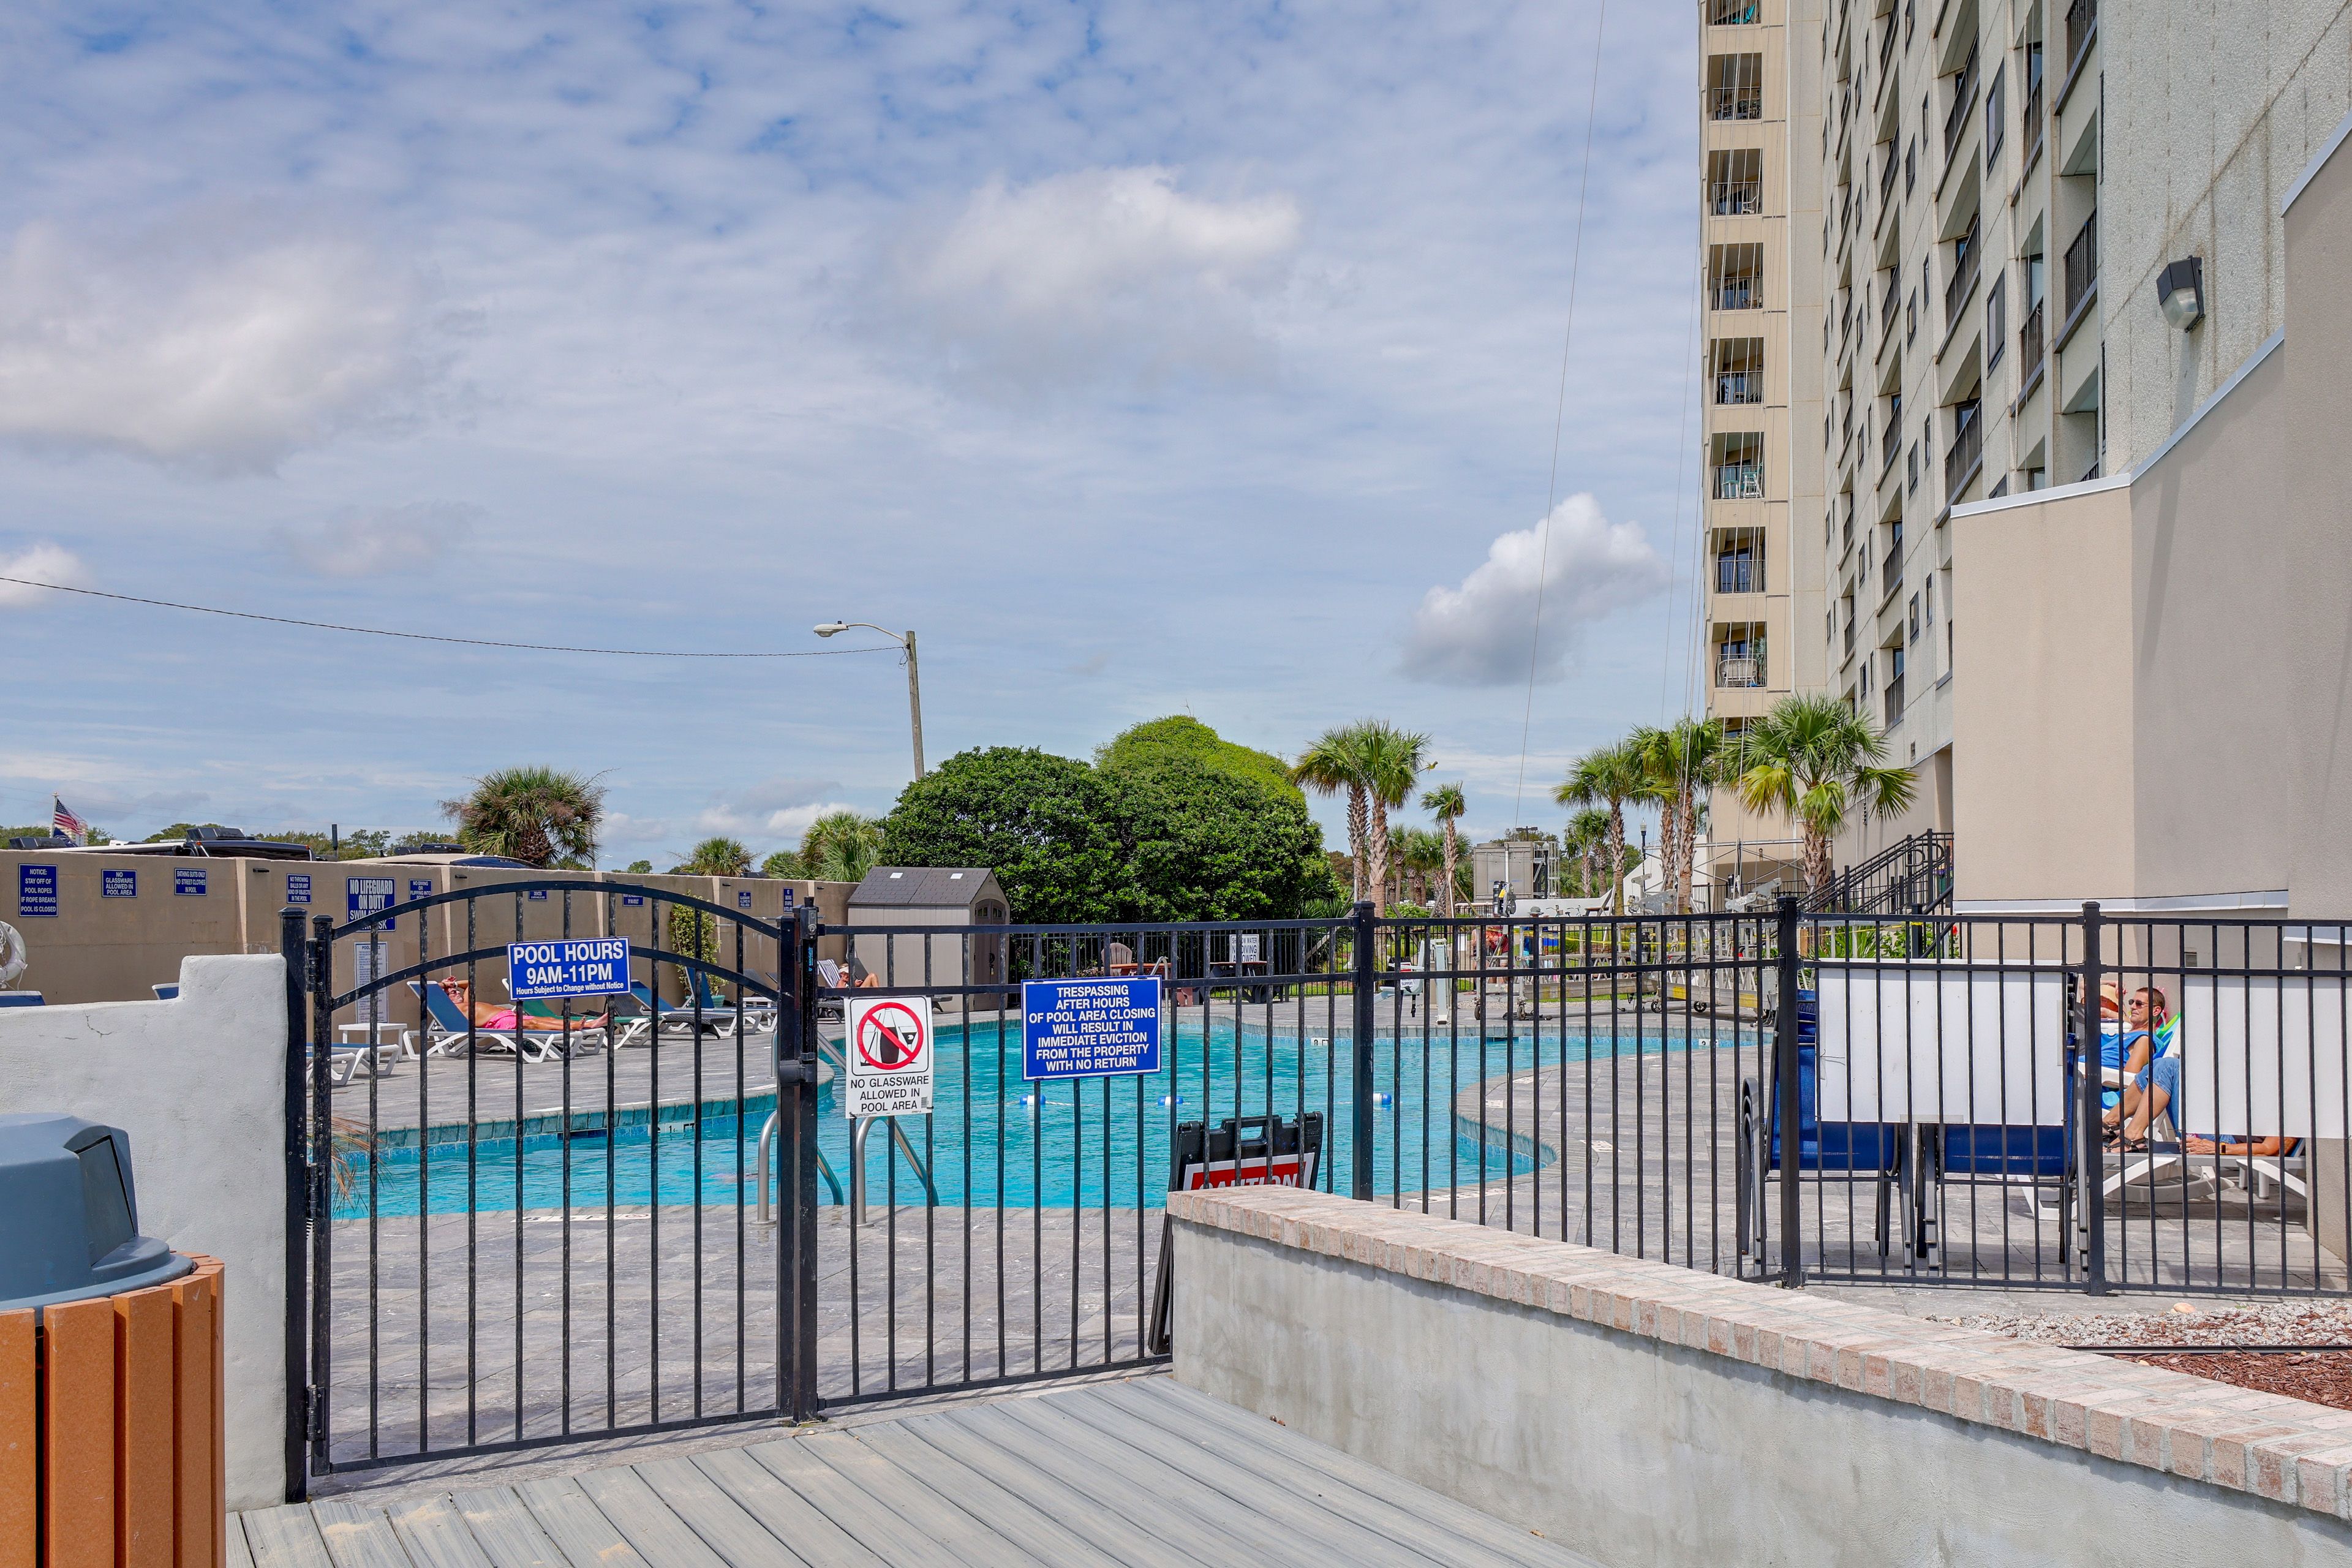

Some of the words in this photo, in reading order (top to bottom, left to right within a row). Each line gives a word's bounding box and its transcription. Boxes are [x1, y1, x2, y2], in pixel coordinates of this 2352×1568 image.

[350, 880, 359, 894] NO
[360, 880, 393, 894] LIFEGUARD
[359, 895, 368, 910] ON
[369, 895, 385, 910] DUTY
[350, 910, 366, 919] SWIM
[513, 945, 560, 964] POOL
[565, 941, 623, 962] HOURS
[526, 963, 612, 985] 9AM-11PM
[534, 985, 556, 994] Subject
[563, 984, 584, 993] Change
[1057, 985, 1129, 998] TRESPASSING
[1056, 998, 1090, 1010] AFTER
[1093, 997, 1130, 1009] HOURS
[1029, 1012, 1044, 1023] OF
[1046, 1011, 1076, 1023] POOL
[1079, 1009, 1107, 1022] AREA
[1110, 1008, 1155, 1020] CLOSING
[1052, 1023, 1078, 1035] WILL
[1080, 1021, 1120, 1033] RESULT
[1123, 1020, 1133, 1031] IN
[1038, 1034, 1097, 1047] IMMEDIATE
[1099, 1032, 1147, 1044] EVICTION
[1036, 1048, 1068, 1060] FROM
[1071, 1047, 1091, 1058] THE
[1094, 1044, 1149, 1057] PROPERTY
[1046, 1060, 1072, 1071] WITH
[1076, 1058, 1091, 1070] NO
[1095, 1057, 1137, 1069] RETURN
[850, 1079, 865, 1088] NO
[870, 1076, 929, 1087] GLASSWARE
[860, 1089, 907, 1100] ALLOWED
[911, 1088, 920, 1097] IN
[861, 1102, 888, 1112] POOL
[892, 1100, 918, 1110] AREA
